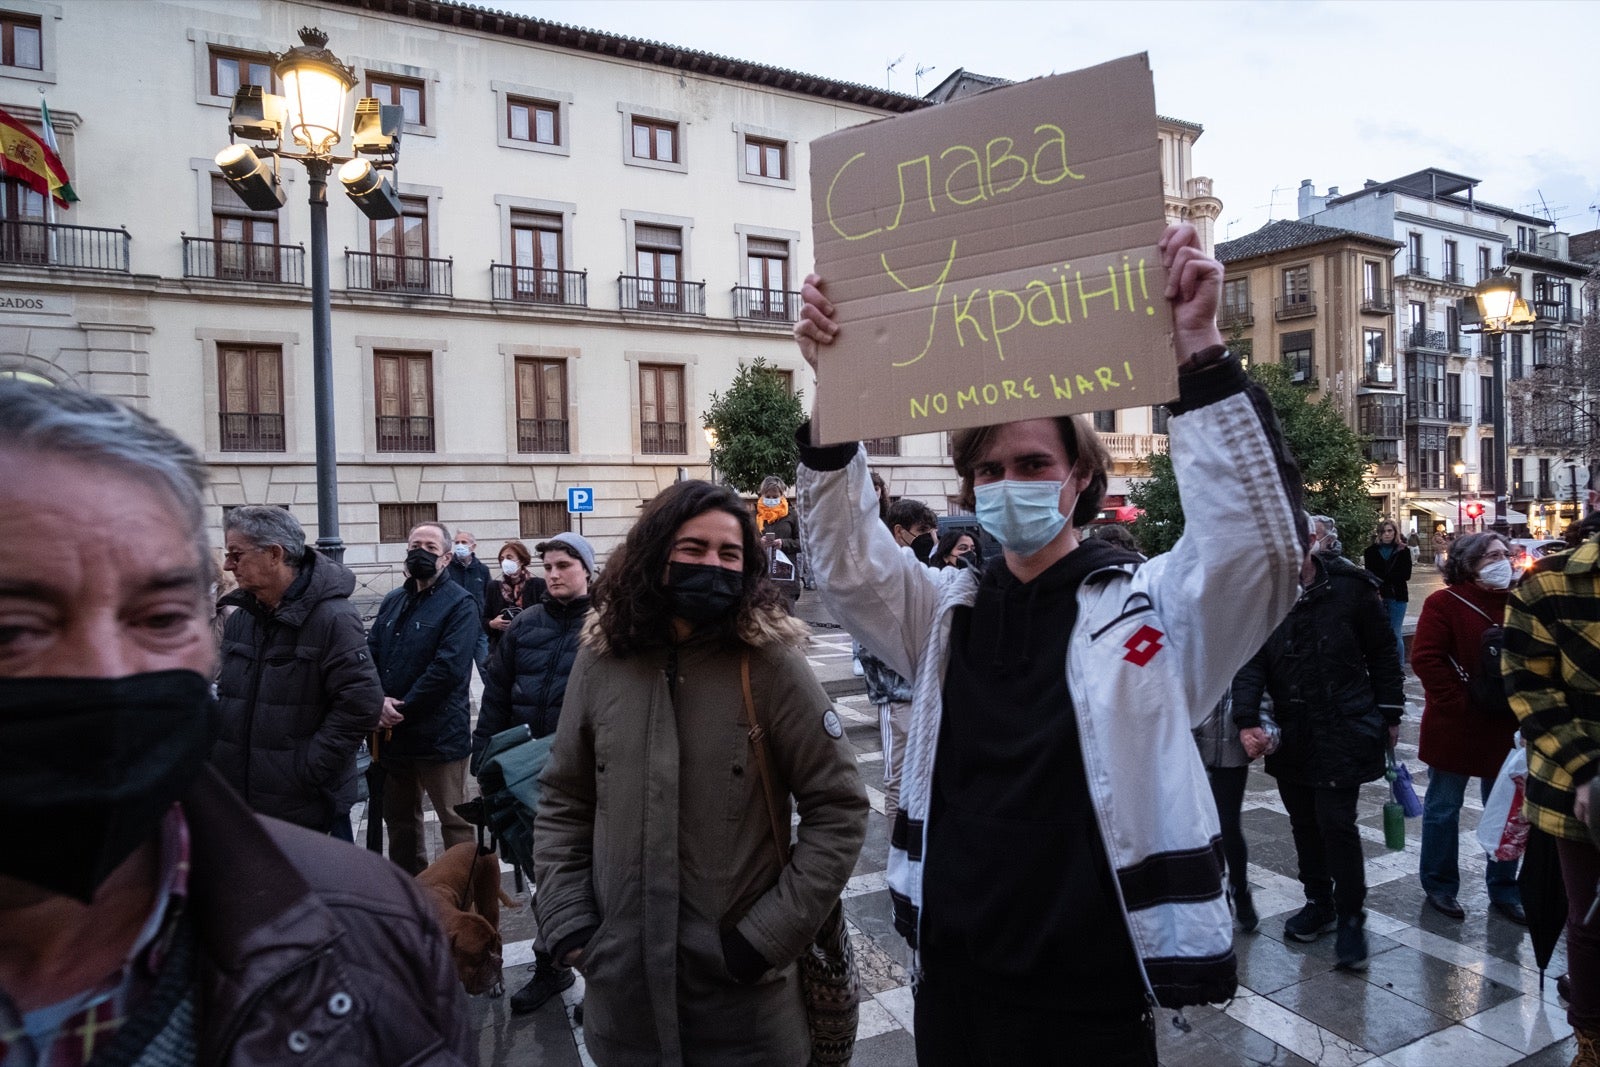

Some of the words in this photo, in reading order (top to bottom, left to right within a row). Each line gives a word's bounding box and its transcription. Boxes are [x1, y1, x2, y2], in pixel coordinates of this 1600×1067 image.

[826, 124, 1085, 241] Слава
[881, 240, 1156, 366] Україні!
[910, 393, 949, 419] NO
[956, 376, 1041, 411] MORE
[1049, 361, 1136, 400] WAR!
[573, 490, 589, 509] P
